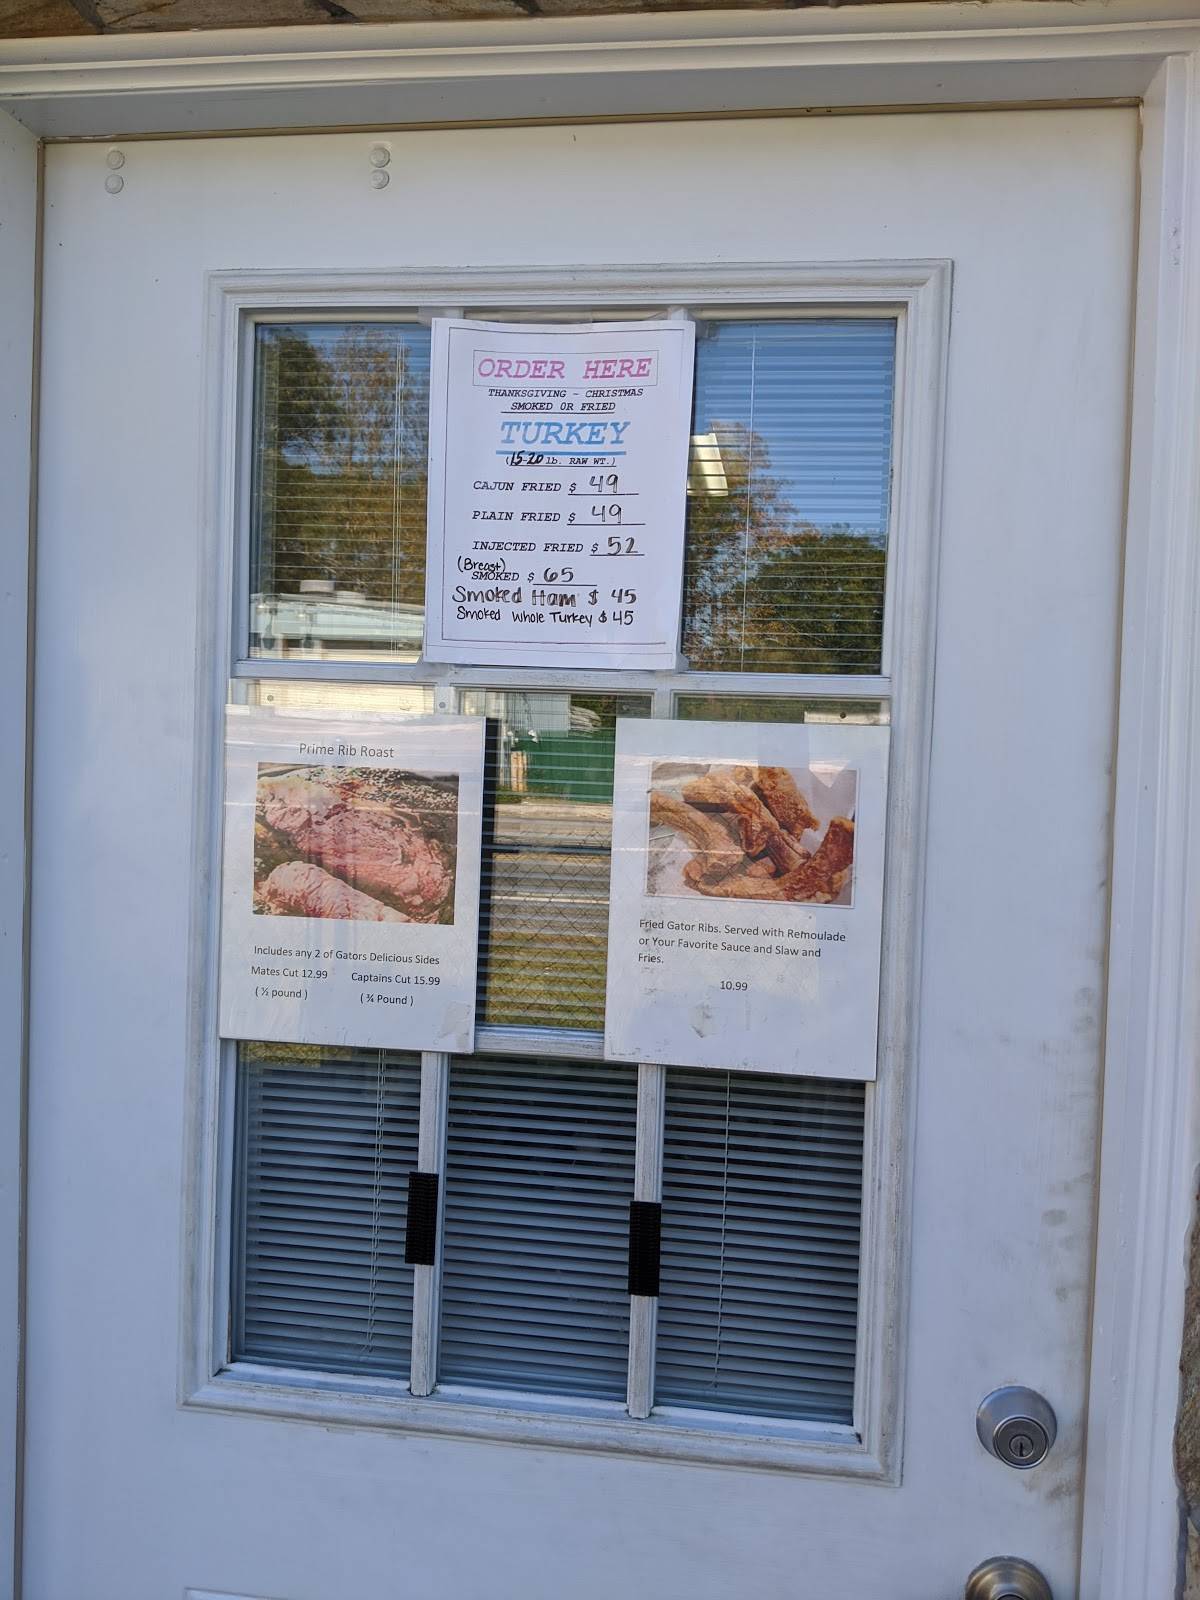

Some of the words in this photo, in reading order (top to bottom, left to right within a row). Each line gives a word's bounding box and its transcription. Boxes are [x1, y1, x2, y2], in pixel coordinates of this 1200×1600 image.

[478, 358, 565, 379] ORDER
[583, 358, 652, 379] HERE
[488, 388, 567, 398] THANKSGIVING
[585, 388, 643, 398] CHRISTMAS
[511, 402, 552, 411] SMOKED
[580, 402, 616, 411] FRIED
[501, 421, 631, 445] TURKEY
[546, 457, 562, 465] lb.
[569, 457, 588, 465] RAW
[594, 457, 616, 466] WT.)
[473, 481, 514, 491] CAJUN
[521, 482, 562, 492] FRIED
[589, 474, 619, 494] 49
[472, 511, 514, 521] PLAIN
[520, 511, 561, 522] FRIED
[591, 503, 622, 524] 49
[472, 541, 536, 552] INJECTED
[543, 542, 584, 553] FRIED
[607, 536, 638, 555] 52
[457, 556, 506, 573] (Breast)
[471, 571, 520, 581] SMOKED
[543, 567, 574, 583] 65
[452, 585, 522, 604] Smoked
[531, 589, 577, 607] Ham
[610, 588, 637, 604] 45
[456, 606, 501, 621] Smoked
[512, 610, 545, 624] Whole
[549, 611, 593, 627] Turkey
[612, 610, 634, 625] 45
[299, 743, 334, 755] Prime
[338, 744, 357, 756] Rib
[360, 745, 395, 758] Roast
[639, 919, 664, 929] Fried
[667, 921, 695, 931] Gator
[698, 923, 721, 933] Ribs.
[724, 924, 759, 935] Served
[761, 927, 784, 937] with
[787, 929, 846, 941] Remoulade
[254, 945, 292, 957] Includes
[295, 949, 312, 959] any
[314, 949, 321, 958] 2
[323, 949, 334, 959] of
[335, 950, 367, 961] Gators
[369, 952, 413, 963] Delicious
[415, 954, 440, 965] Sides
[652, 937, 675, 947] Your
[678, 938, 718, 950] Favorite
[721, 941, 750, 952] Sauce
[753, 945, 772, 954] and
[775, 945, 799, 955] Slaw
[802, 948, 821, 957] and
[638, 953, 664, 963] Fries.
[251, 966, 280, 976] Mates
[282, 968, 299, 977] Cut
[301, 969, 328, 979] 12.99
[351, 972, 392, 983] Captains
[394, 974, 411, 984] Cut
[414, 976, 441, 986] 15.99
[271, 989, 302, 998] pound
[720, 981, 748, 991] 10.99
[377, 994, 408, 1005] Pound
